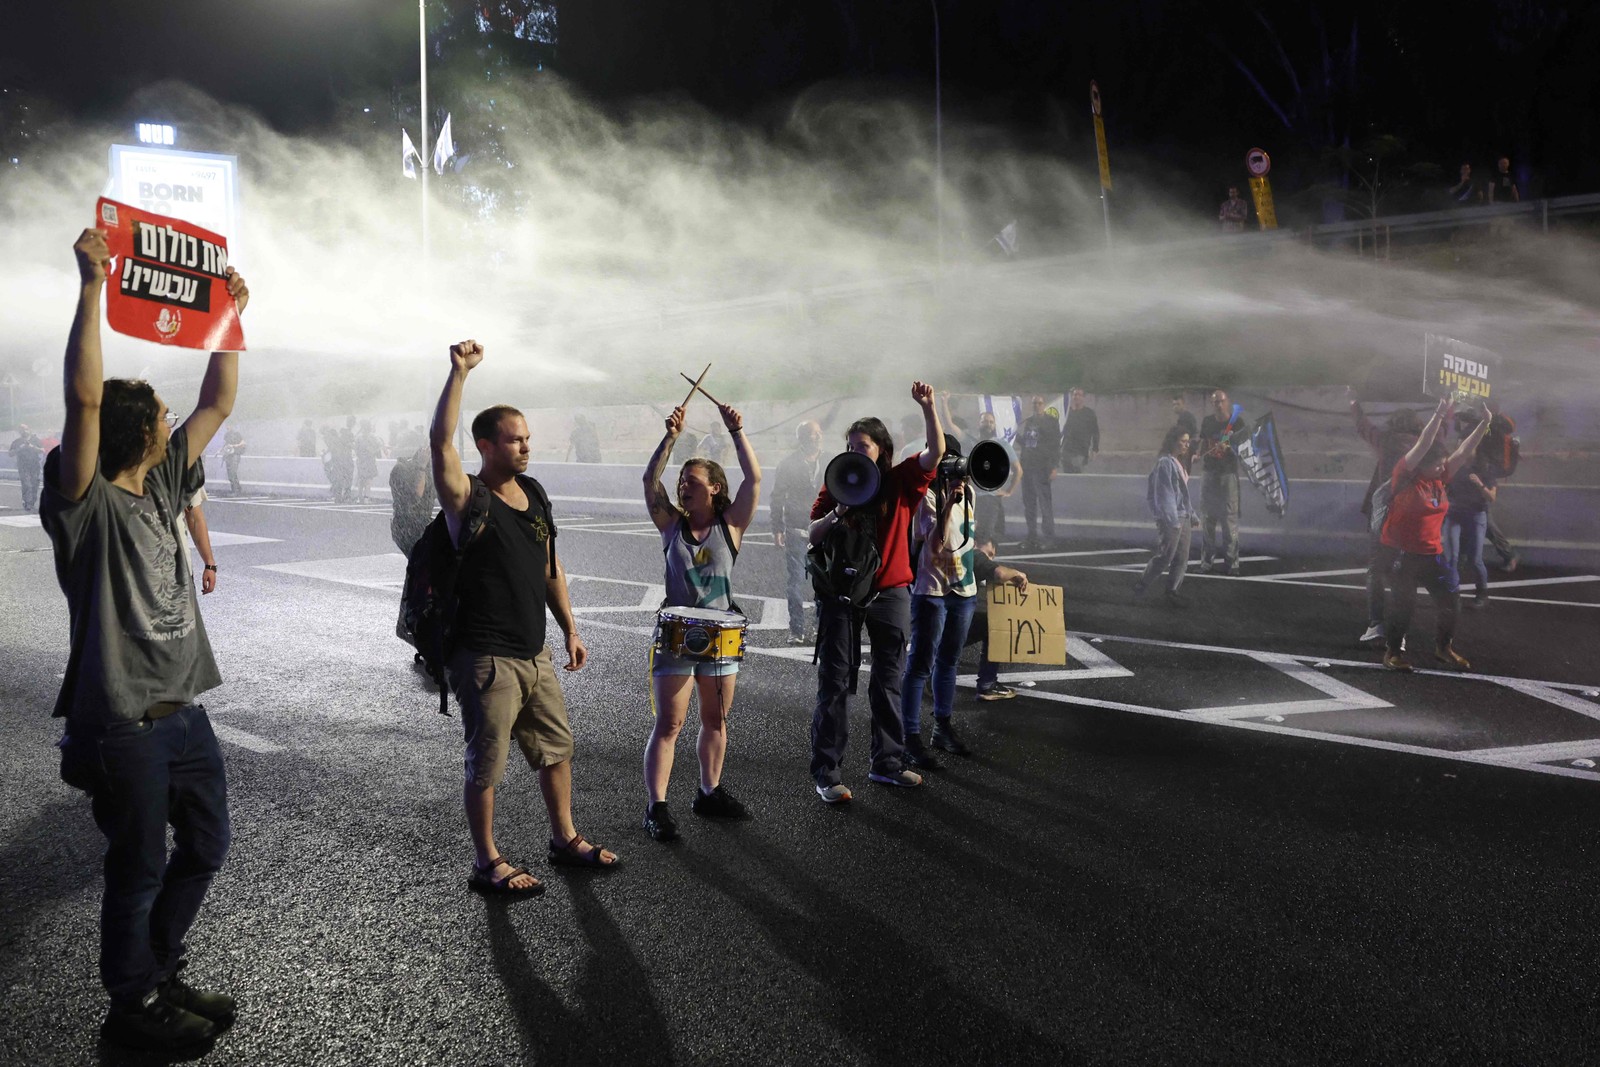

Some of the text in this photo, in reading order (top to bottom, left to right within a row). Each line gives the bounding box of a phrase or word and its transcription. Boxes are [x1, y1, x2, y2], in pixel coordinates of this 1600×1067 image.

[138, 182, 204, 202] BORN
[139, 199, 172, 217] TO
[121, 258, 198, 303] עכשיו!
[1444, 354, 1488, 379] עסקה
[1439, 369, 1491, 398] עכשיו!
[1036, 588, 1057, 611] אין
[1007, 618, 1045, 662] זמן
